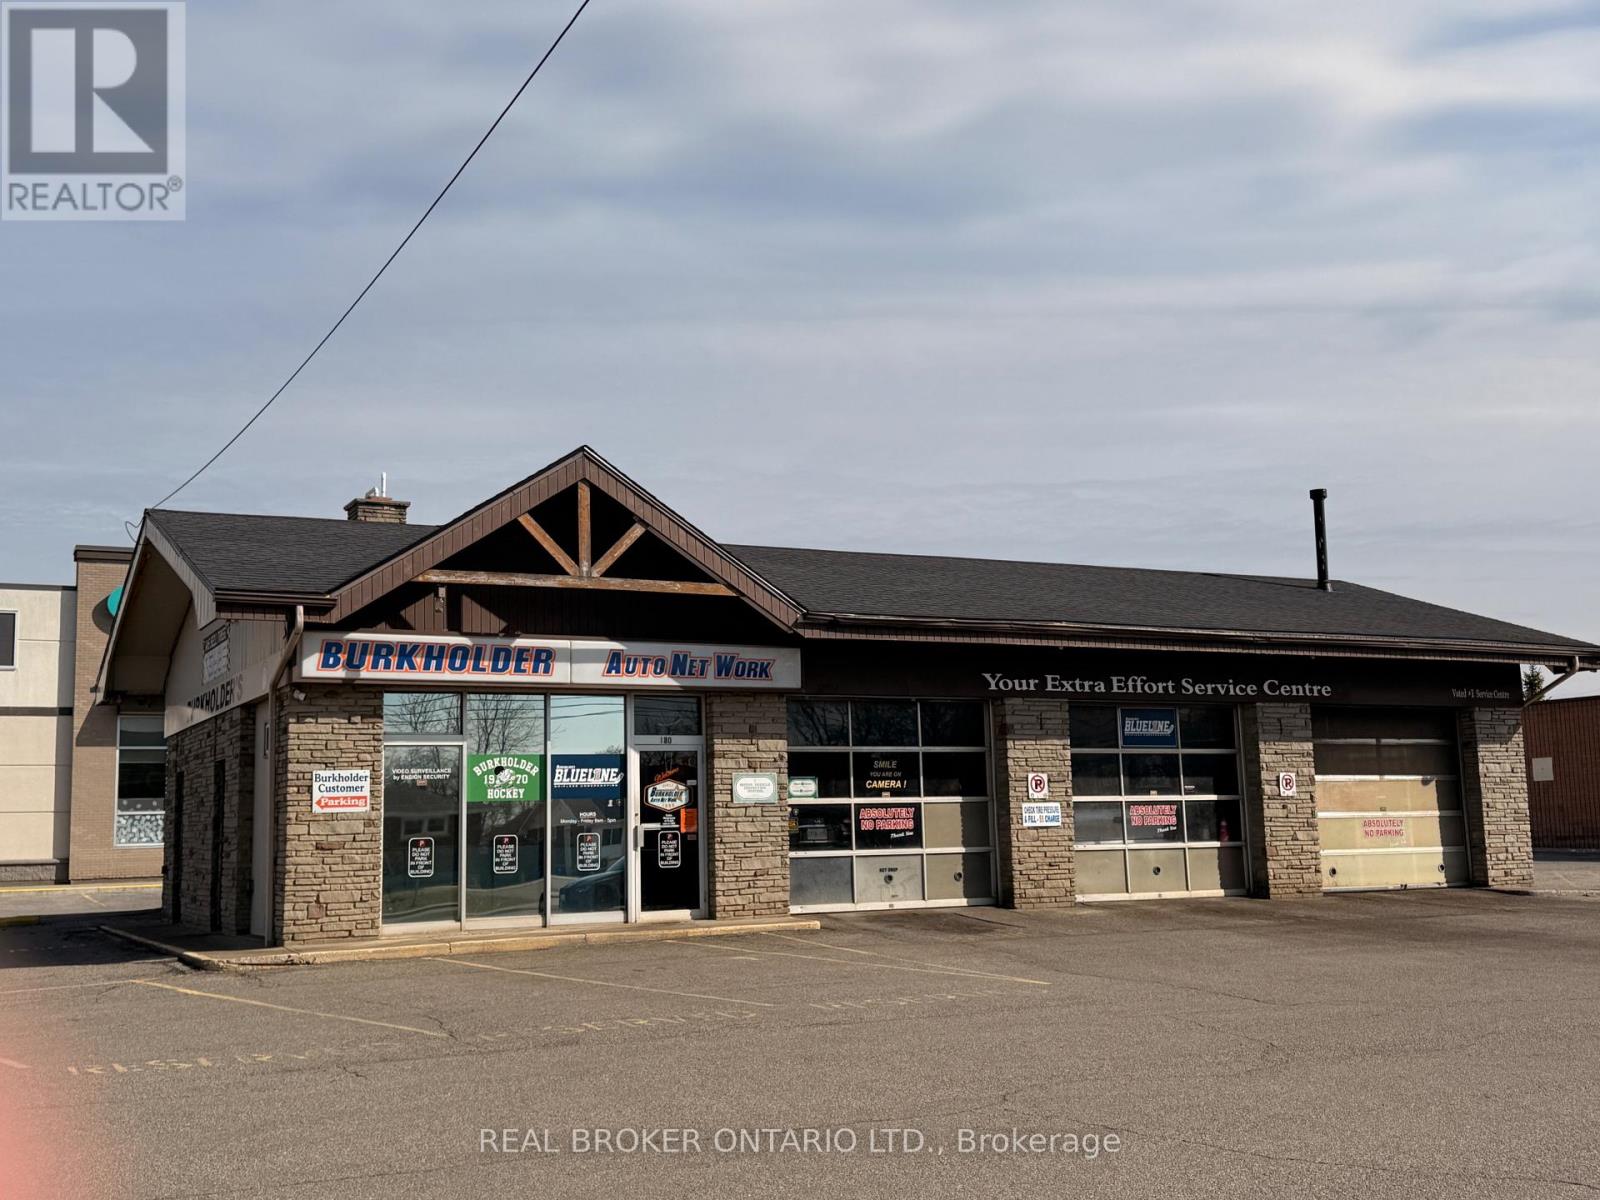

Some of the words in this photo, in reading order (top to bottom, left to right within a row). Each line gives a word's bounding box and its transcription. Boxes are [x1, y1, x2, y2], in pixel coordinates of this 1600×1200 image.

[317, 640, 556, 676] BURKHOLDER
[982, 673, 1038, 690] Your
[1045, 674, 1106, 692] Extra
[1110, 676, 1176, 694] Effort
[1181, 678, 1258, 695] Service
[1263, 680, 1332, 696] Centre
[473, 757, 540, 776] BURKHOLDER
[315, 773, 368, 783] Burkholder
[318, 784, 364, 793] Customer
[487, 788, 525, 799] HOCKEY
[320, 797, 366, 807] Parking
[860, 808, 915, 819] ABSOLUTELY
[1130, 805, 1177, 815] ABSOLUTELY
[861, 820, 874, 830] NO
[876, 819, 914, 830] PARKING
[1131, 816, 1142, 826] NO
[1143, 816, 1177, 825] PARKING
